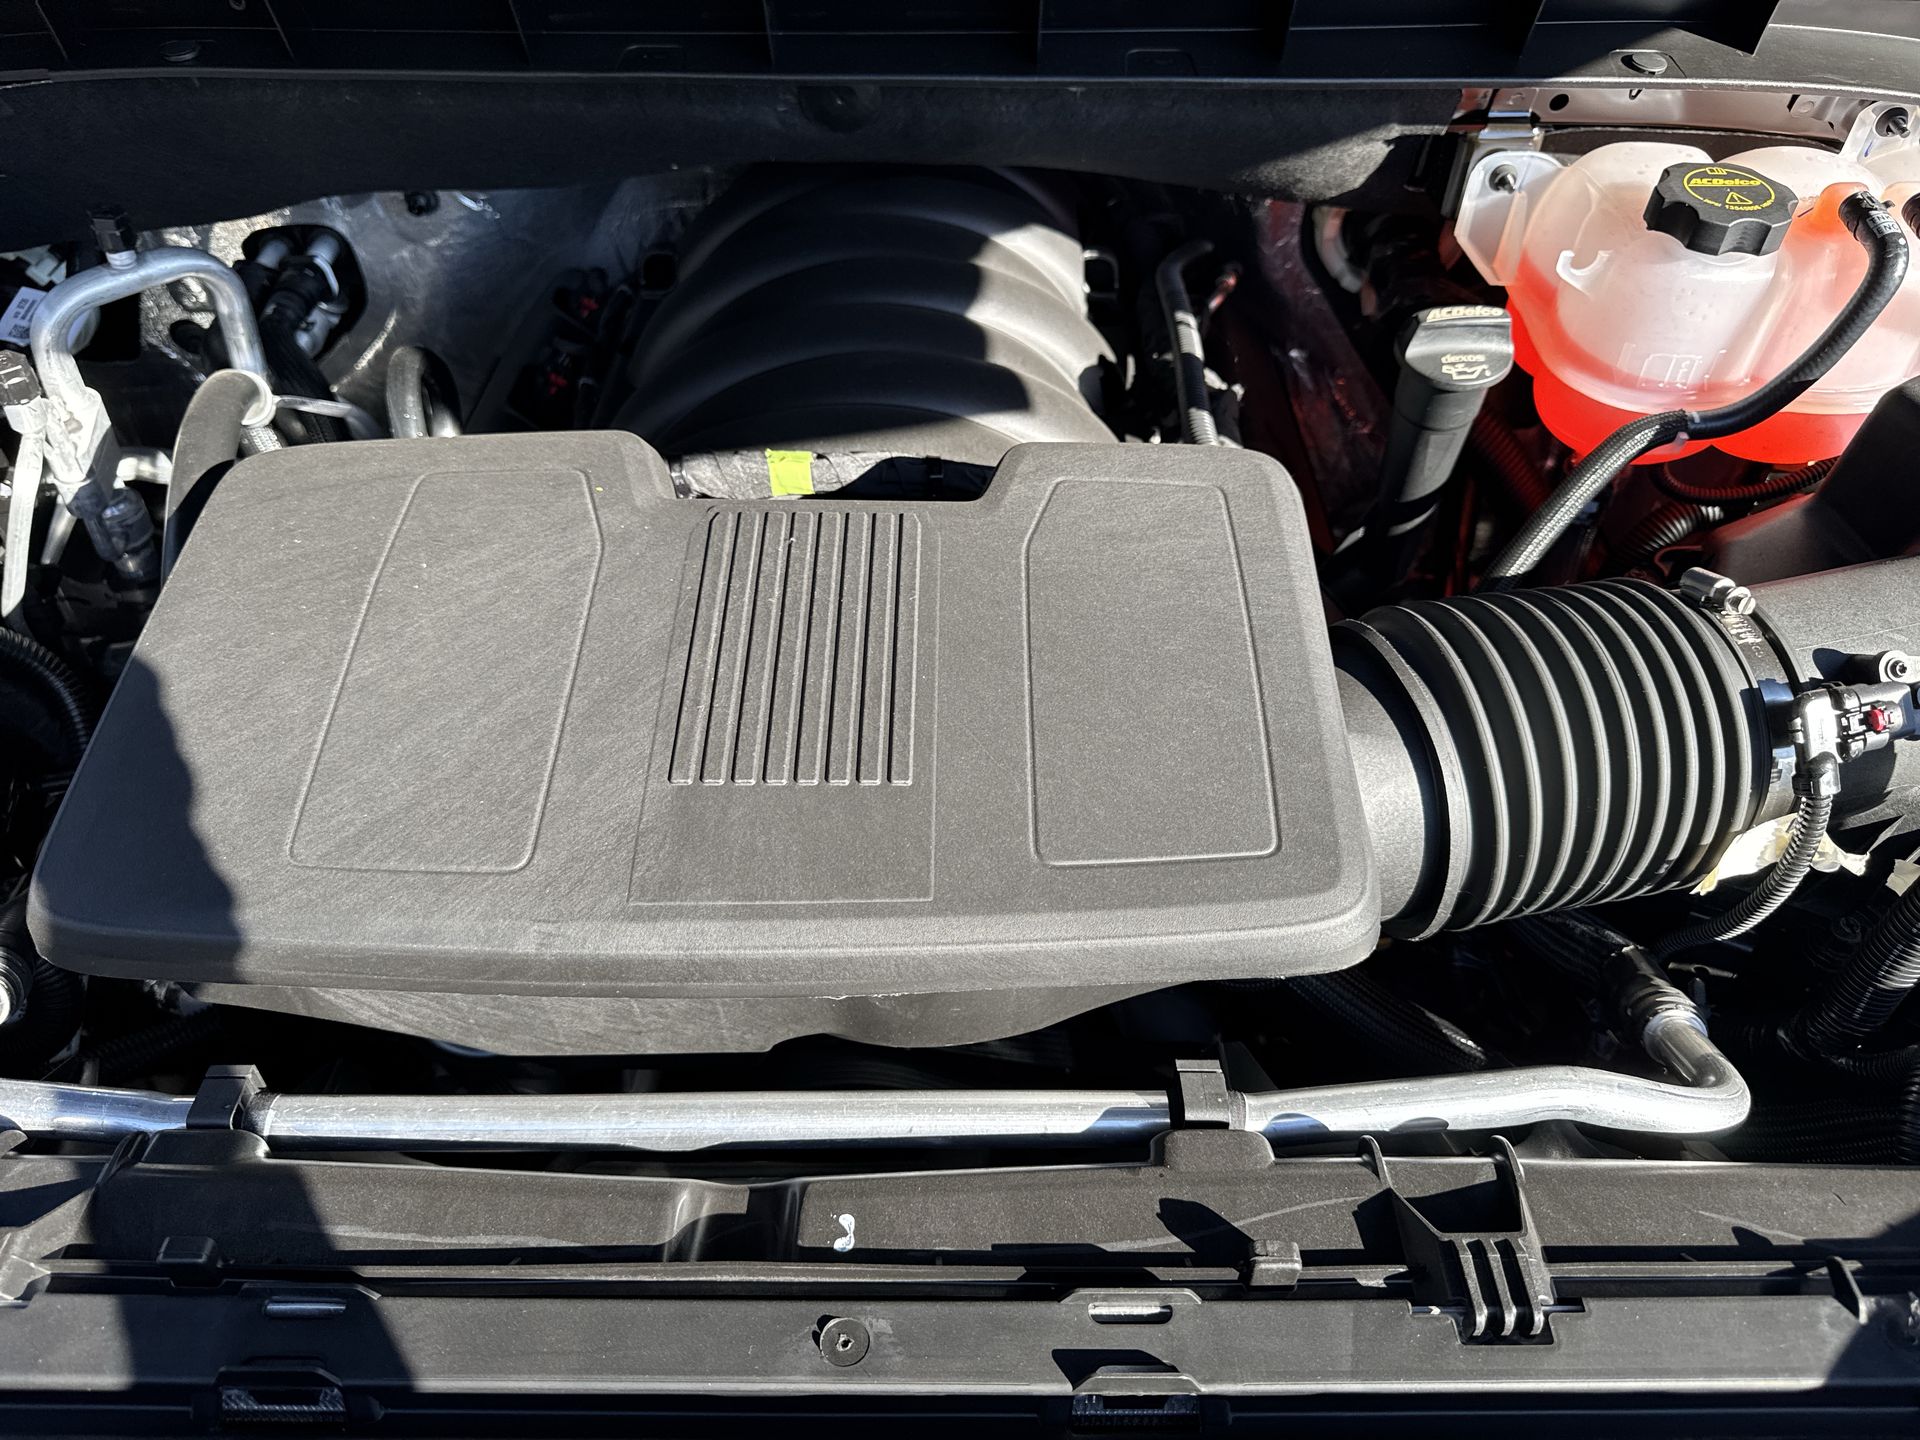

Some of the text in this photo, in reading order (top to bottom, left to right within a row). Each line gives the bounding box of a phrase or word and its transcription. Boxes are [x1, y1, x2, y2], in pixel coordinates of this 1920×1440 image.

[1688, 178, 1762, 187] ACDelco
[1426, 306, 1505, 322] ACDelco
[1441, 354, 1486, 363] dexos
